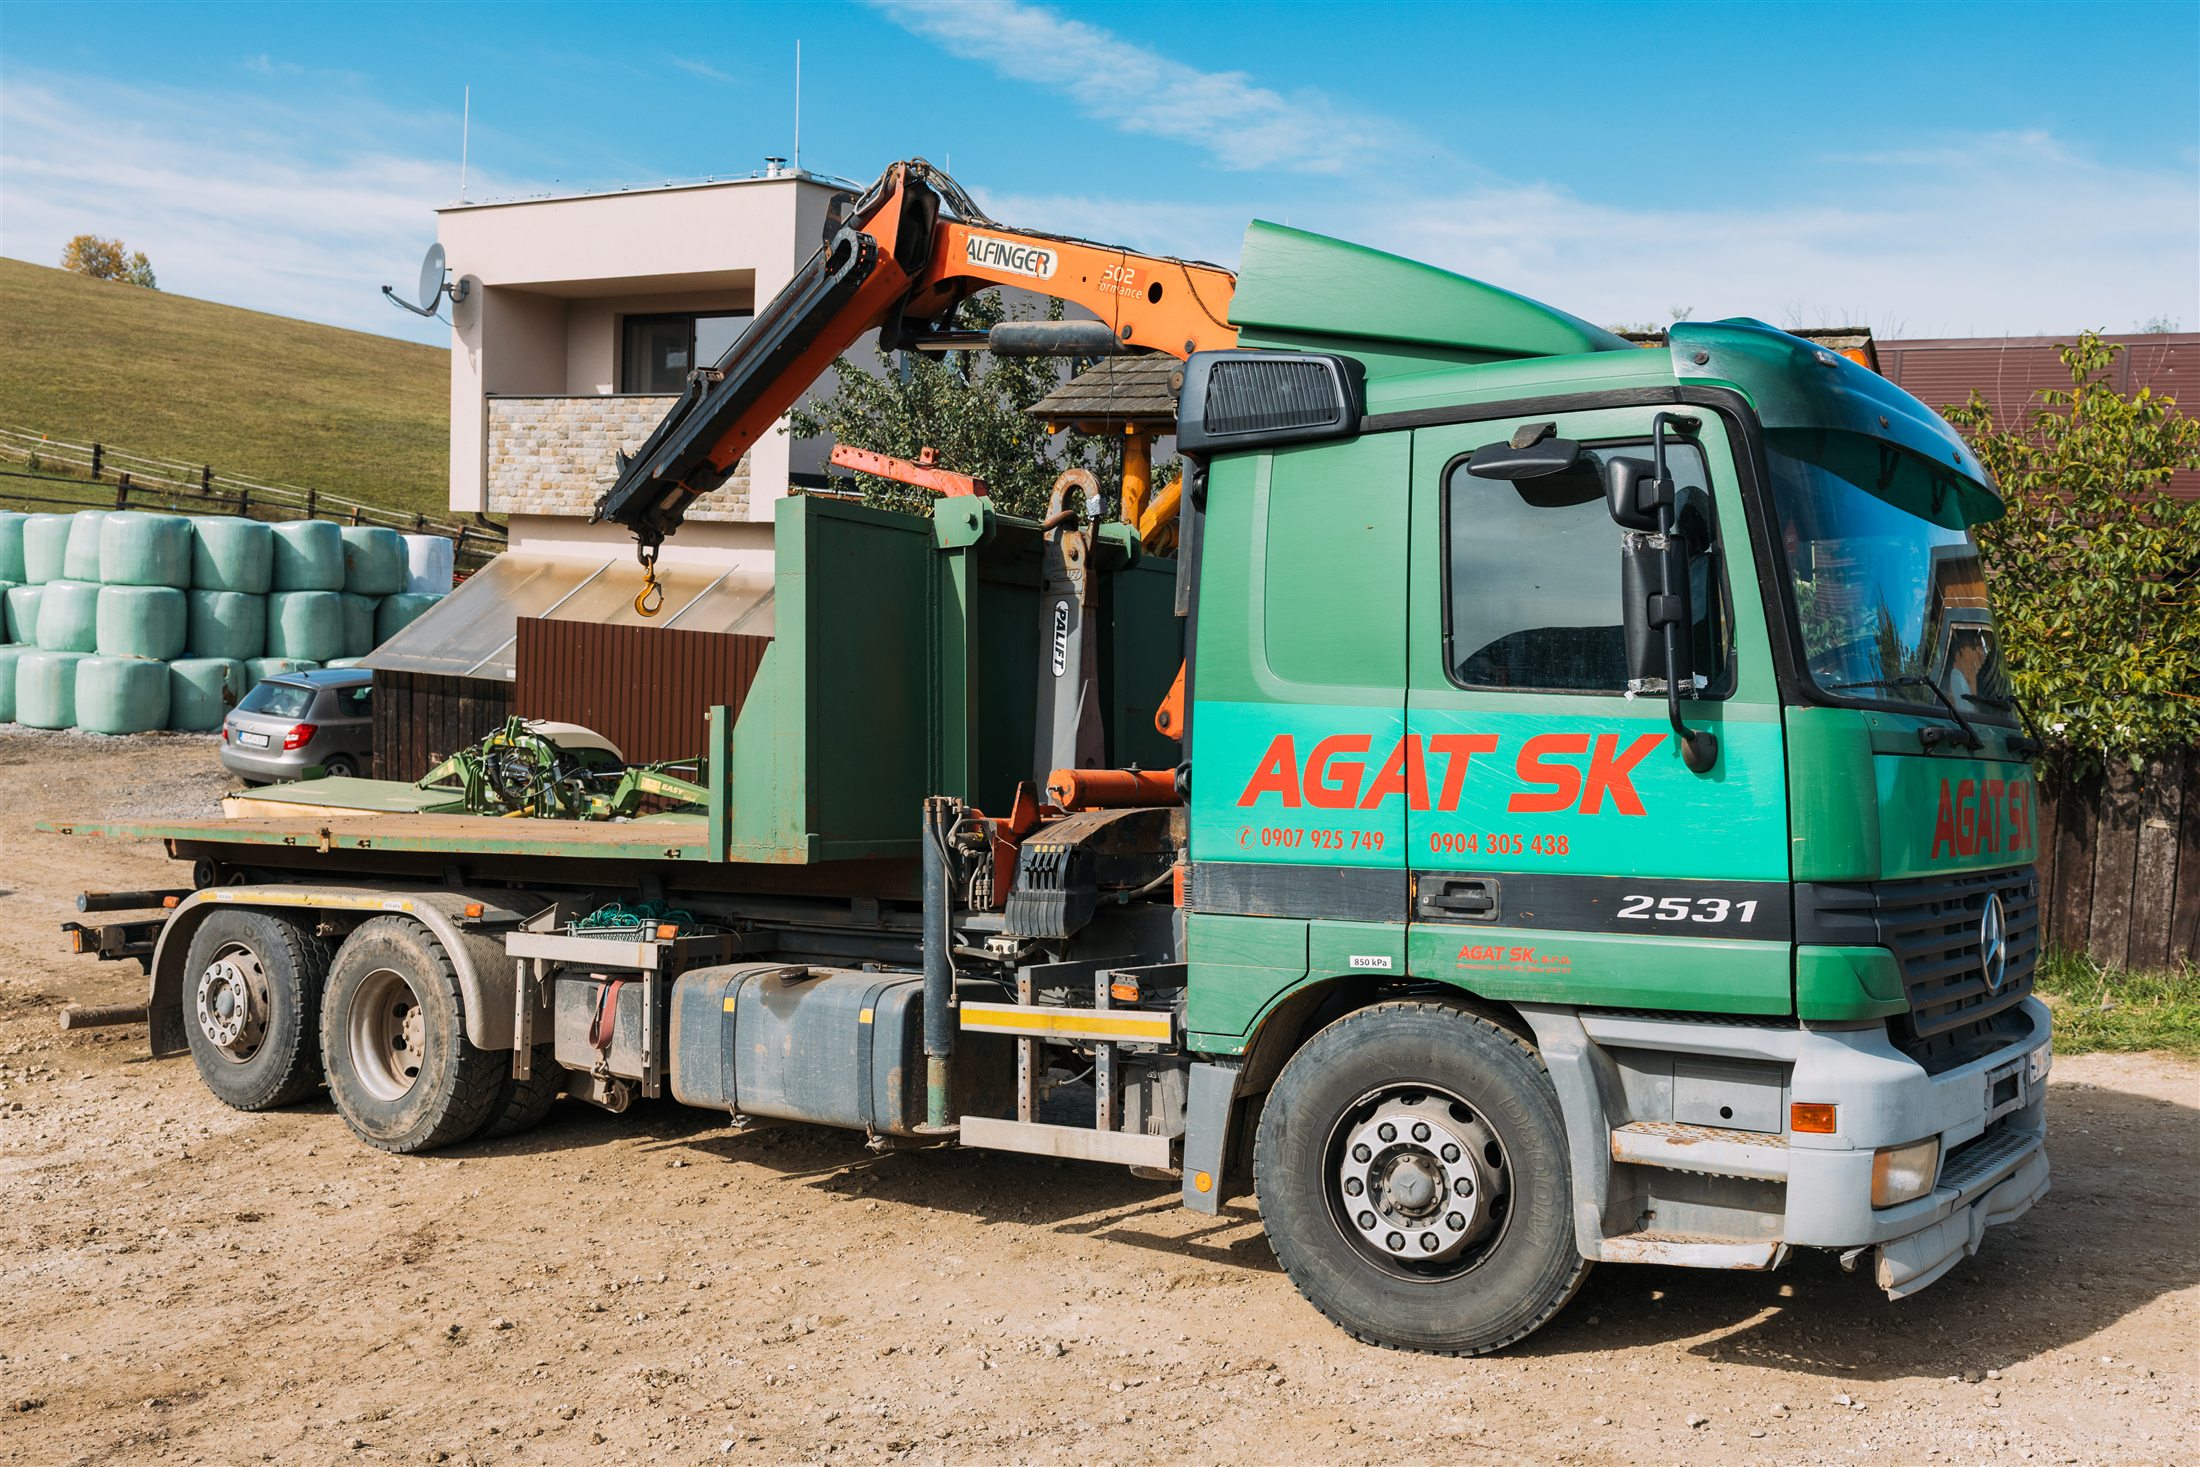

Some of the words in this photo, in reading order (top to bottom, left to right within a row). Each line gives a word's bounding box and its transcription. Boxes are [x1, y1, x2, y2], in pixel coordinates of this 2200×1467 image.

[1103, 264, 1135, 285] 502
[1096, 280, 1142, 299] ormance
[1054, 606, 1067, 669] PALIFT
[1236, 734, 1499, 812] AGAT
[1507, 733, 1669, 816] SK
[1931, 778, 2005, 859] AGAT
[2008, 780, 2032, 851] SK
[1261, 827, 1304, 848] 0907
[1310, 829, 1344, 849] 925
[1351, 830, 1385, 850] 749
[1429, 832, 1478, 854] 0904
[1486, 833, 1523, 855] 305
[1530, 834, 1569, 856] 438
[1617, 895, 1758, 923] 2531
[1354, 958, 1370, 966] 850
[1371, 958, 1387, 967] kPa
[1457, 944, 1506, 960] AGAT
[1541, 955, 1572, 965] s.r.o.
[1498, 1096, 1554, 1249] D800M
